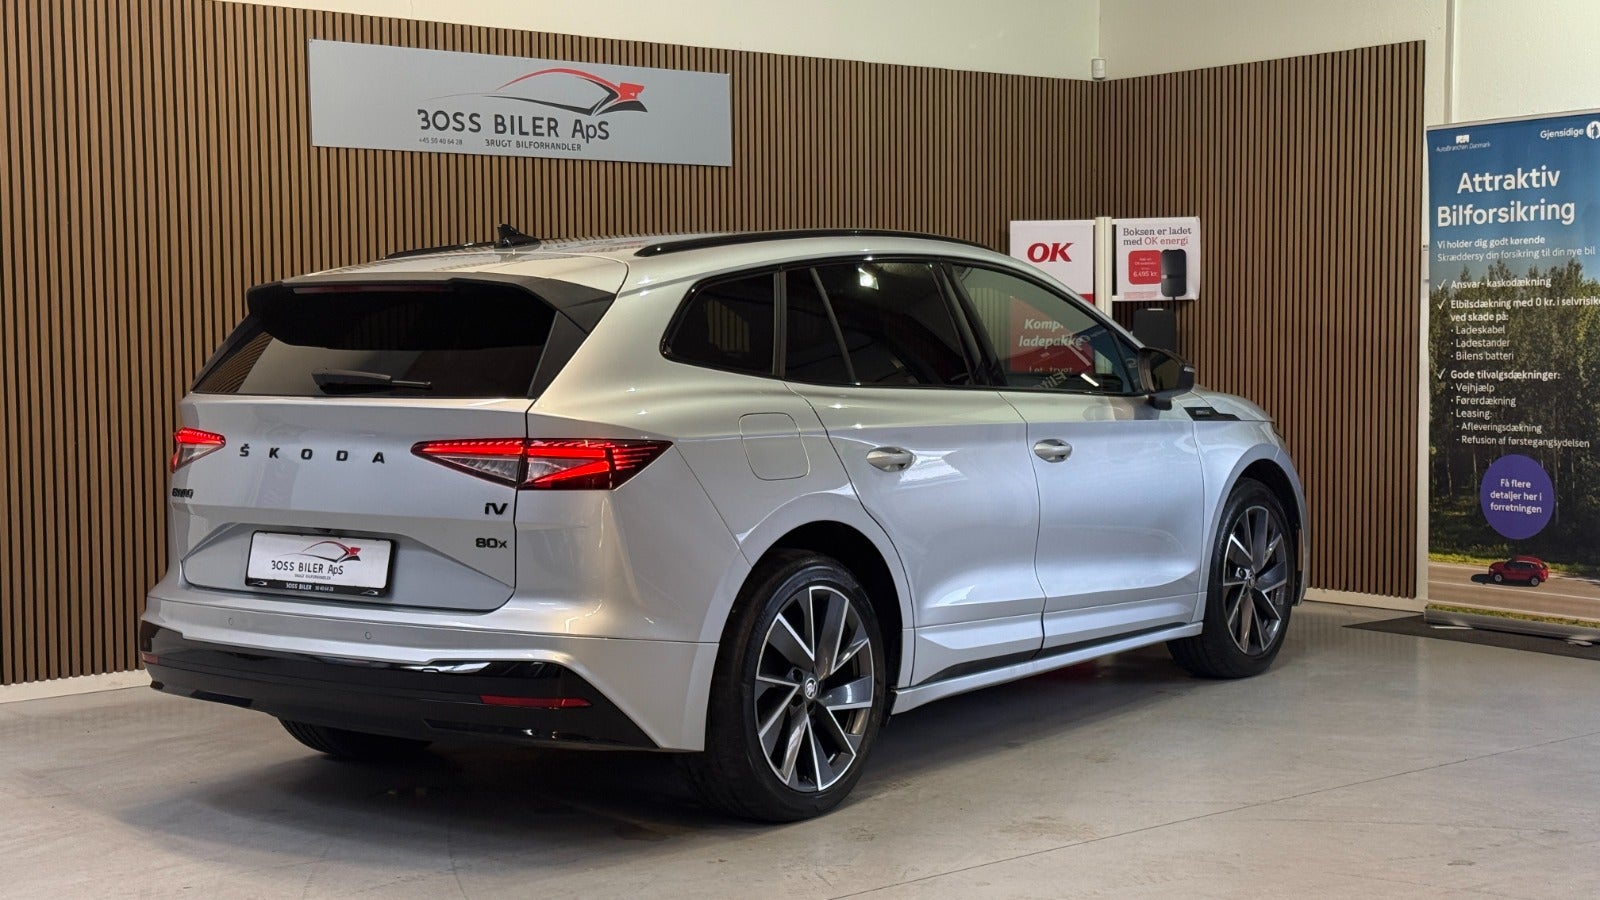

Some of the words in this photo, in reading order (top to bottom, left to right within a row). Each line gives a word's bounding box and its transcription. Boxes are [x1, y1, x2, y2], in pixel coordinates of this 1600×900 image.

[494, 114, 559, 137] BILER
[571, 119, 610, 143] ApS
[1540, 127, 1584, 140] Gjensidige
[516, 141, 582, 151] BILFORHANDLER
[1457, 165, 1560, 194] Attraktiv
[1438, 198, 1575, 227] Bilforsikring
[1123, 227, 1155, 236] Boksen
[1169, 227, 1192, 235] ladet
[1124, 238, 1142, 246] med
[1145, 237, 1158, 245] OK
[1160, 237, 1188, 246] energi
[1437, 240, 1446, 249] Vi
[1446, 240, 1472, 249] holder
[1474, 238, 1488, 249] dig
[1490, 238, 1509, 248] godt
[1510, 236, 1545, 245] kørende
[1027, 242, 1073, 263] OK
[1437, 252, 1485, 262] Skræddersy
[1486, 251, 1500, 260] din
[1501, 250, 1540, 260] forsikring
[1541, 248, 1550, 257] til
[1552, 247, 1565, 257] din
[1567, 249, 1582, 258] nye
[1585, 246, 1595, 255] bil
[1487, 277, 1551, 288] kaskodækning
[1451, 299, 1511, 310] Elbilsdækning
[1513, 298, 1533, 307] med
[1536, 297, 1541, 306] 0
[1544, 297, 1555, 306] kr.
[1450, 313, 1466, 322] ved
[1468, 312, 1494, 321] skade
[1496, 311, 1509, 323] på:
[1456, 326, 1505, 334] Ladeskabel
[1456, 339, 1510, 348] Ladestander
[1456, 352, 1483, 361] Bilens
[1486, 352, 1514, 361] batteri
[1451, 370, 1474, 379] Gode
[1477, 370, 1561, 381] tilvalgsdækninger:
[1456, 383, 1495, 393] Vejhjælp
[1456, 396, 1516, 407] Førerdækning
[1461, 422, 1542, 434] Afleveringsdækning
[1461, 435, 1497, 445] Refusion
[1498, 436, 1506, 445] af
[1508, 437, 1590, 449] førstegangsydelsen
[239, 443, 385, 464] ŠKODA
[1500, 479, 1510, 487] Få
[1511, 479, 1531, 488] flere
[1490, 491, 1521, 502] detaljer
[1523, 492, 1537, 500] her
[1490, 504, 1542, 514] forretningen
[298, 562, 323, 573] BILER
[328, 564, 343, 576] ApS
